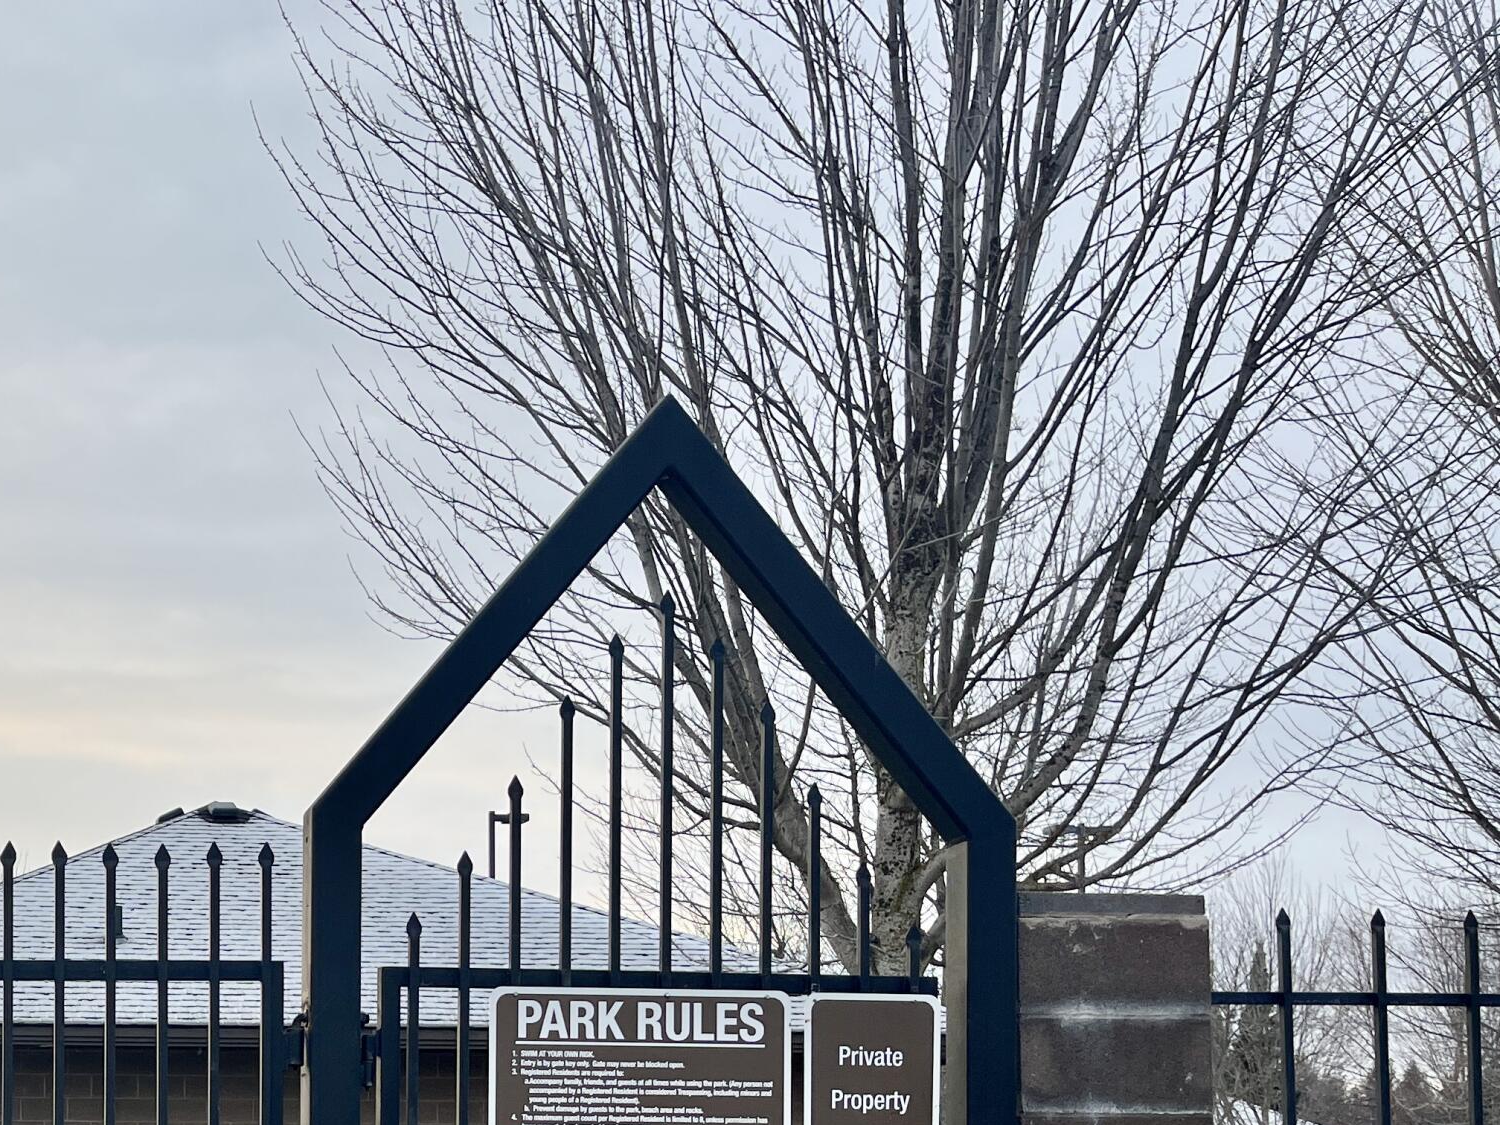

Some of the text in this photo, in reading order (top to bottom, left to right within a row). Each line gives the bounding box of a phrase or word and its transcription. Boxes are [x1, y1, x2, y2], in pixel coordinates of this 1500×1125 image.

[518, 1000, 764, 1042] PARK RULES
[840, 1046, 903, 1066] Private
[832, 1090, 910, 1114] Property
